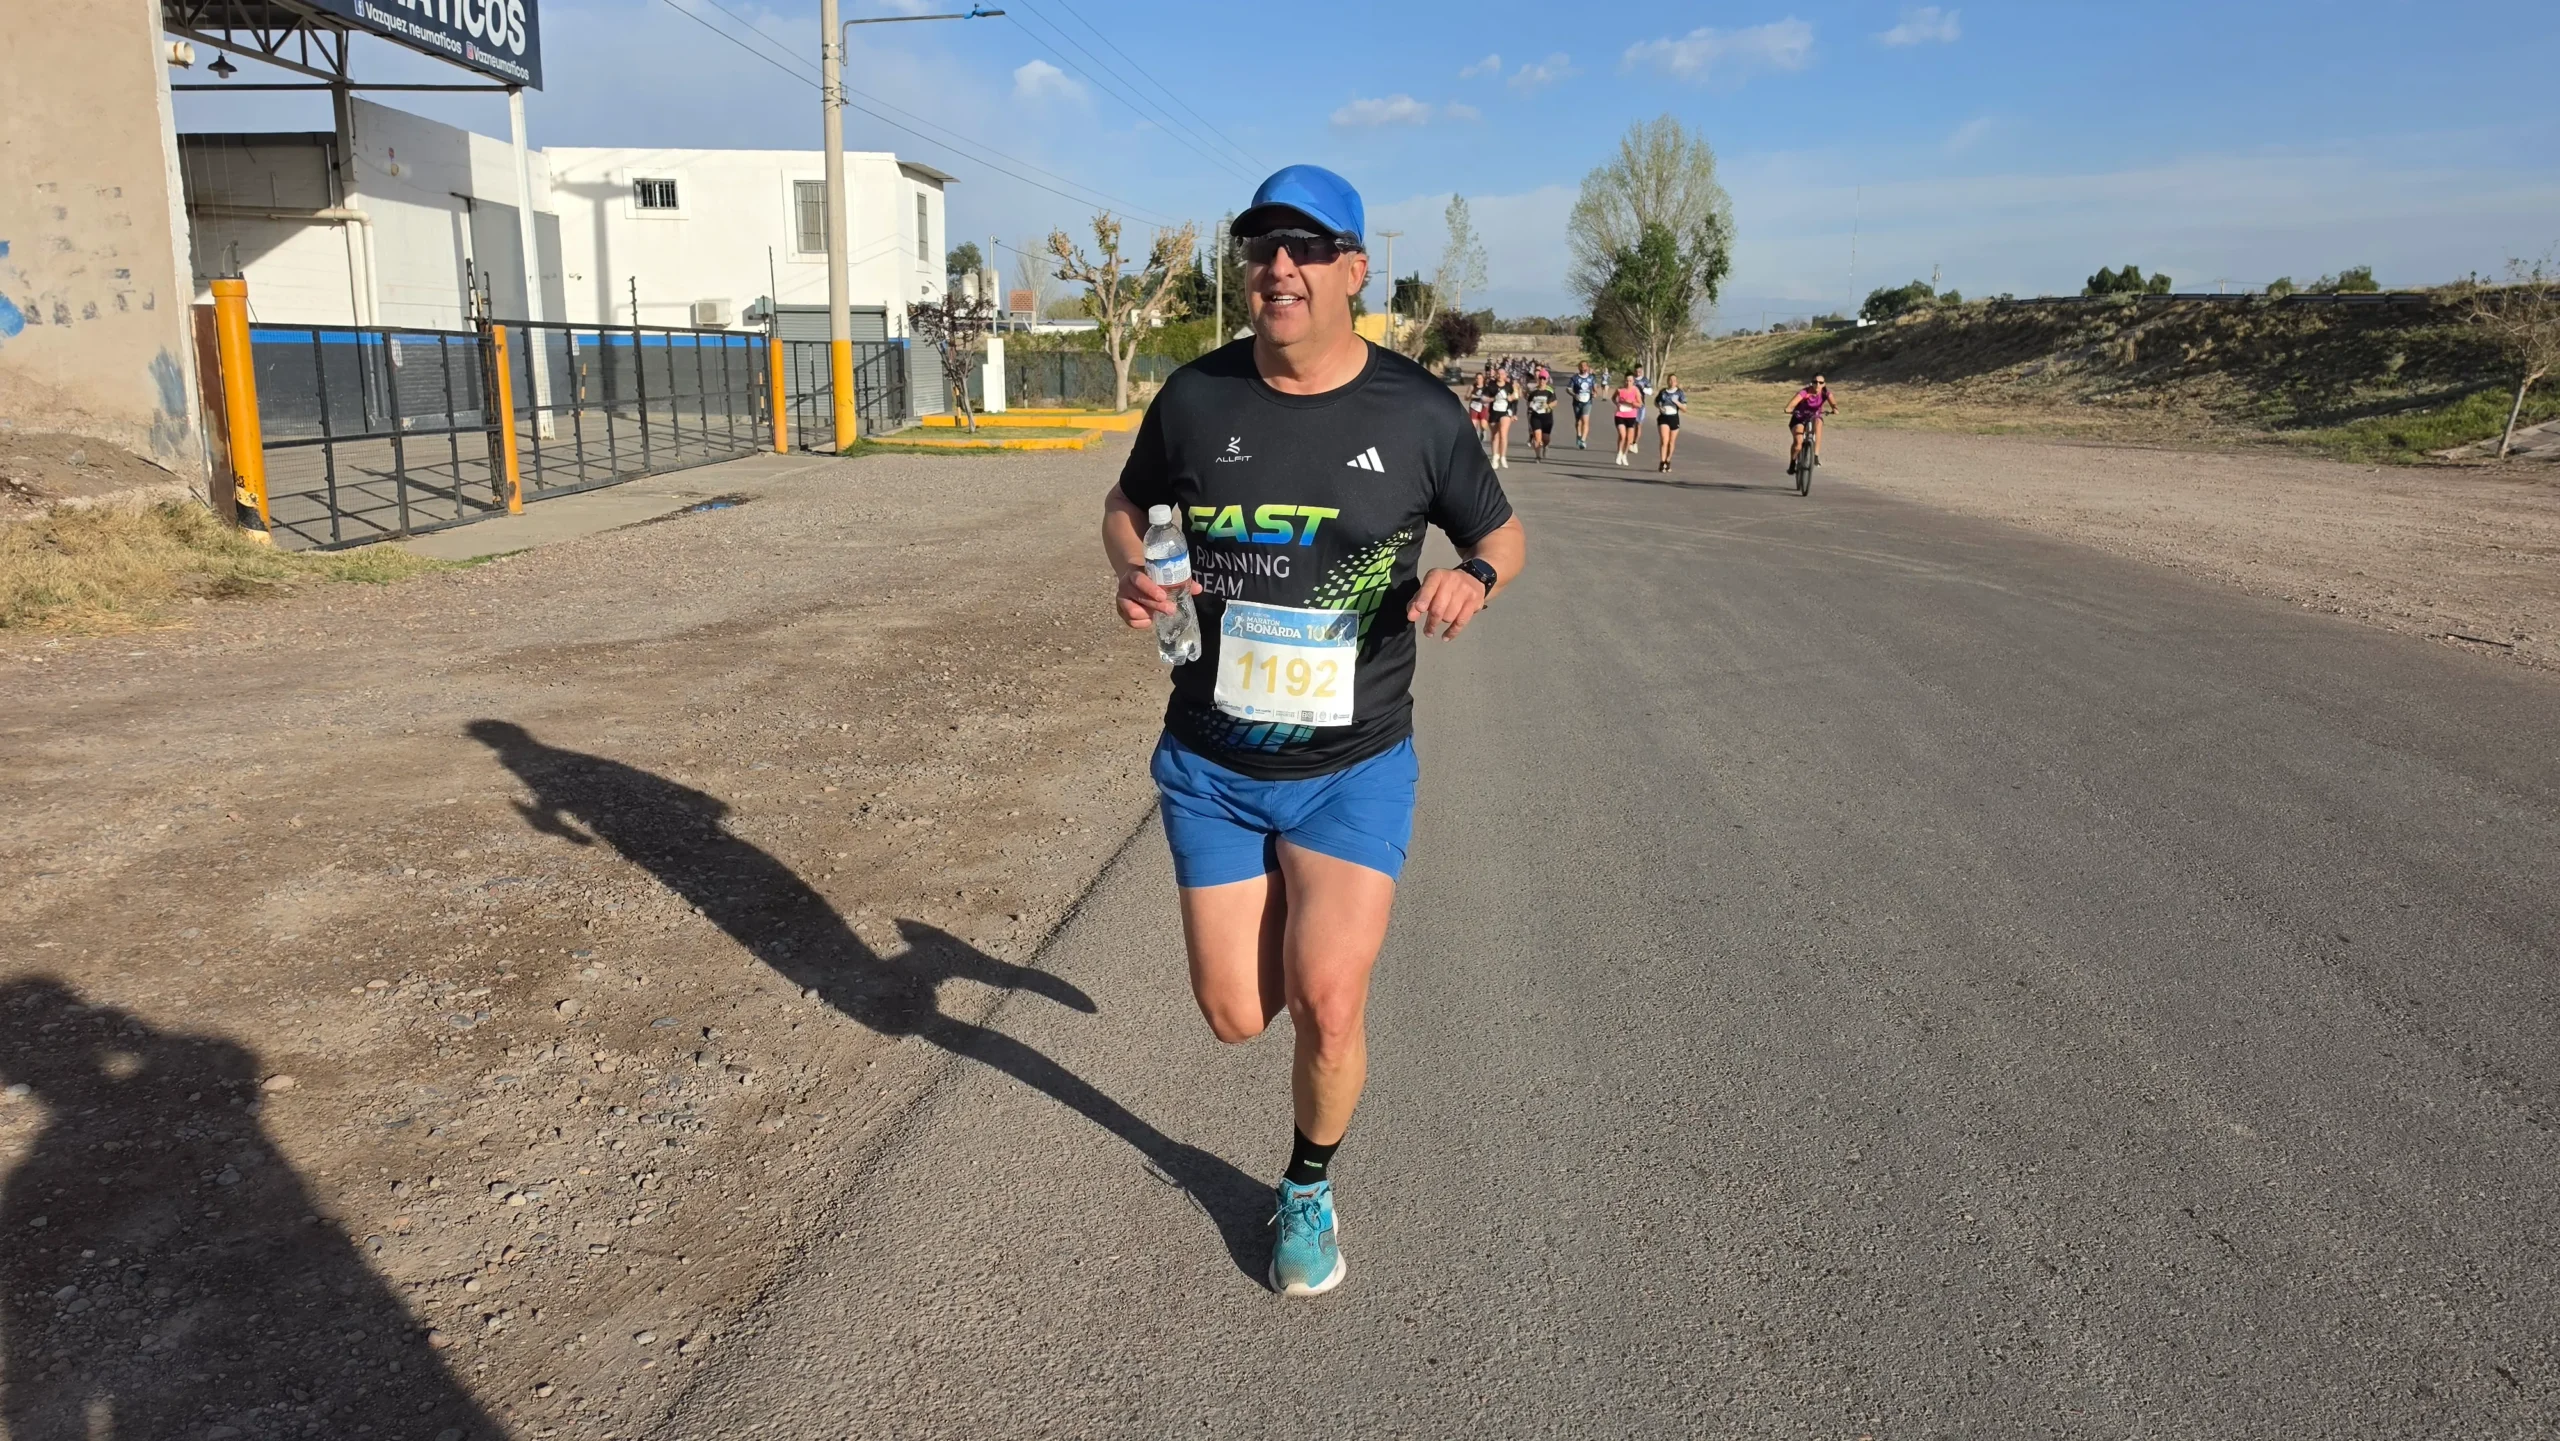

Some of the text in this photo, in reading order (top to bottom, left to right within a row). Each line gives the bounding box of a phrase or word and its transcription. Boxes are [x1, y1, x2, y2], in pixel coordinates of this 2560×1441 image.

[364, 1, 463, 54] Vazquez neumaticos
[1215, 455, 1253, 463] ALLFIT
[1187, 503, 1341, 547] FAST
[1196, 545, 1291, 578] RUNNING
[1191, 570, 1244, 600] TEAM
[1246, 622, 1302, 639] BONARDA
[1237, 651, 1339, 698] 1192
